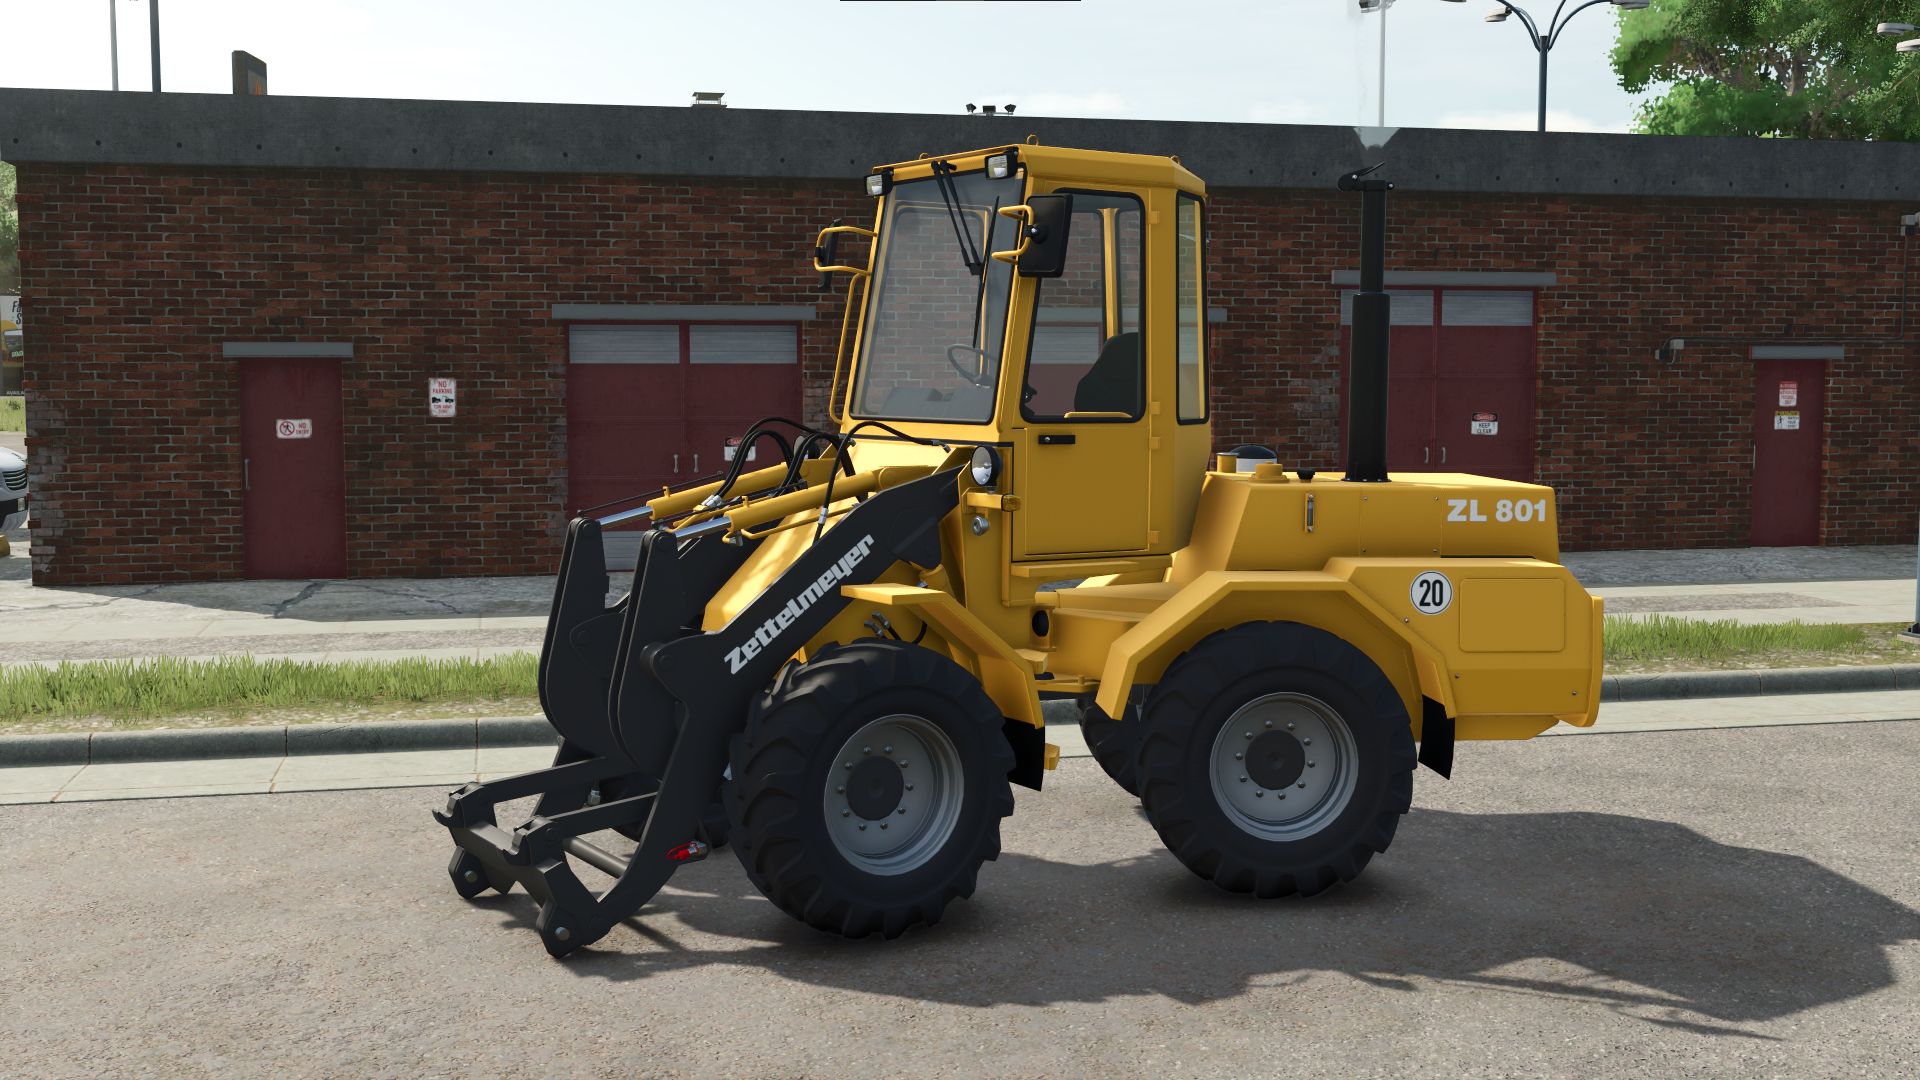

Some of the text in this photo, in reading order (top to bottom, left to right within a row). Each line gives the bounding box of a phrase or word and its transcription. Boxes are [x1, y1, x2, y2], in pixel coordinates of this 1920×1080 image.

[437, 380, 447, 388] NO
[1447, 499, 1546, 522] ZL 801
[724, 534, 875, 675] Zettelmeyer
[1419, 579, 1443, 606] 20
